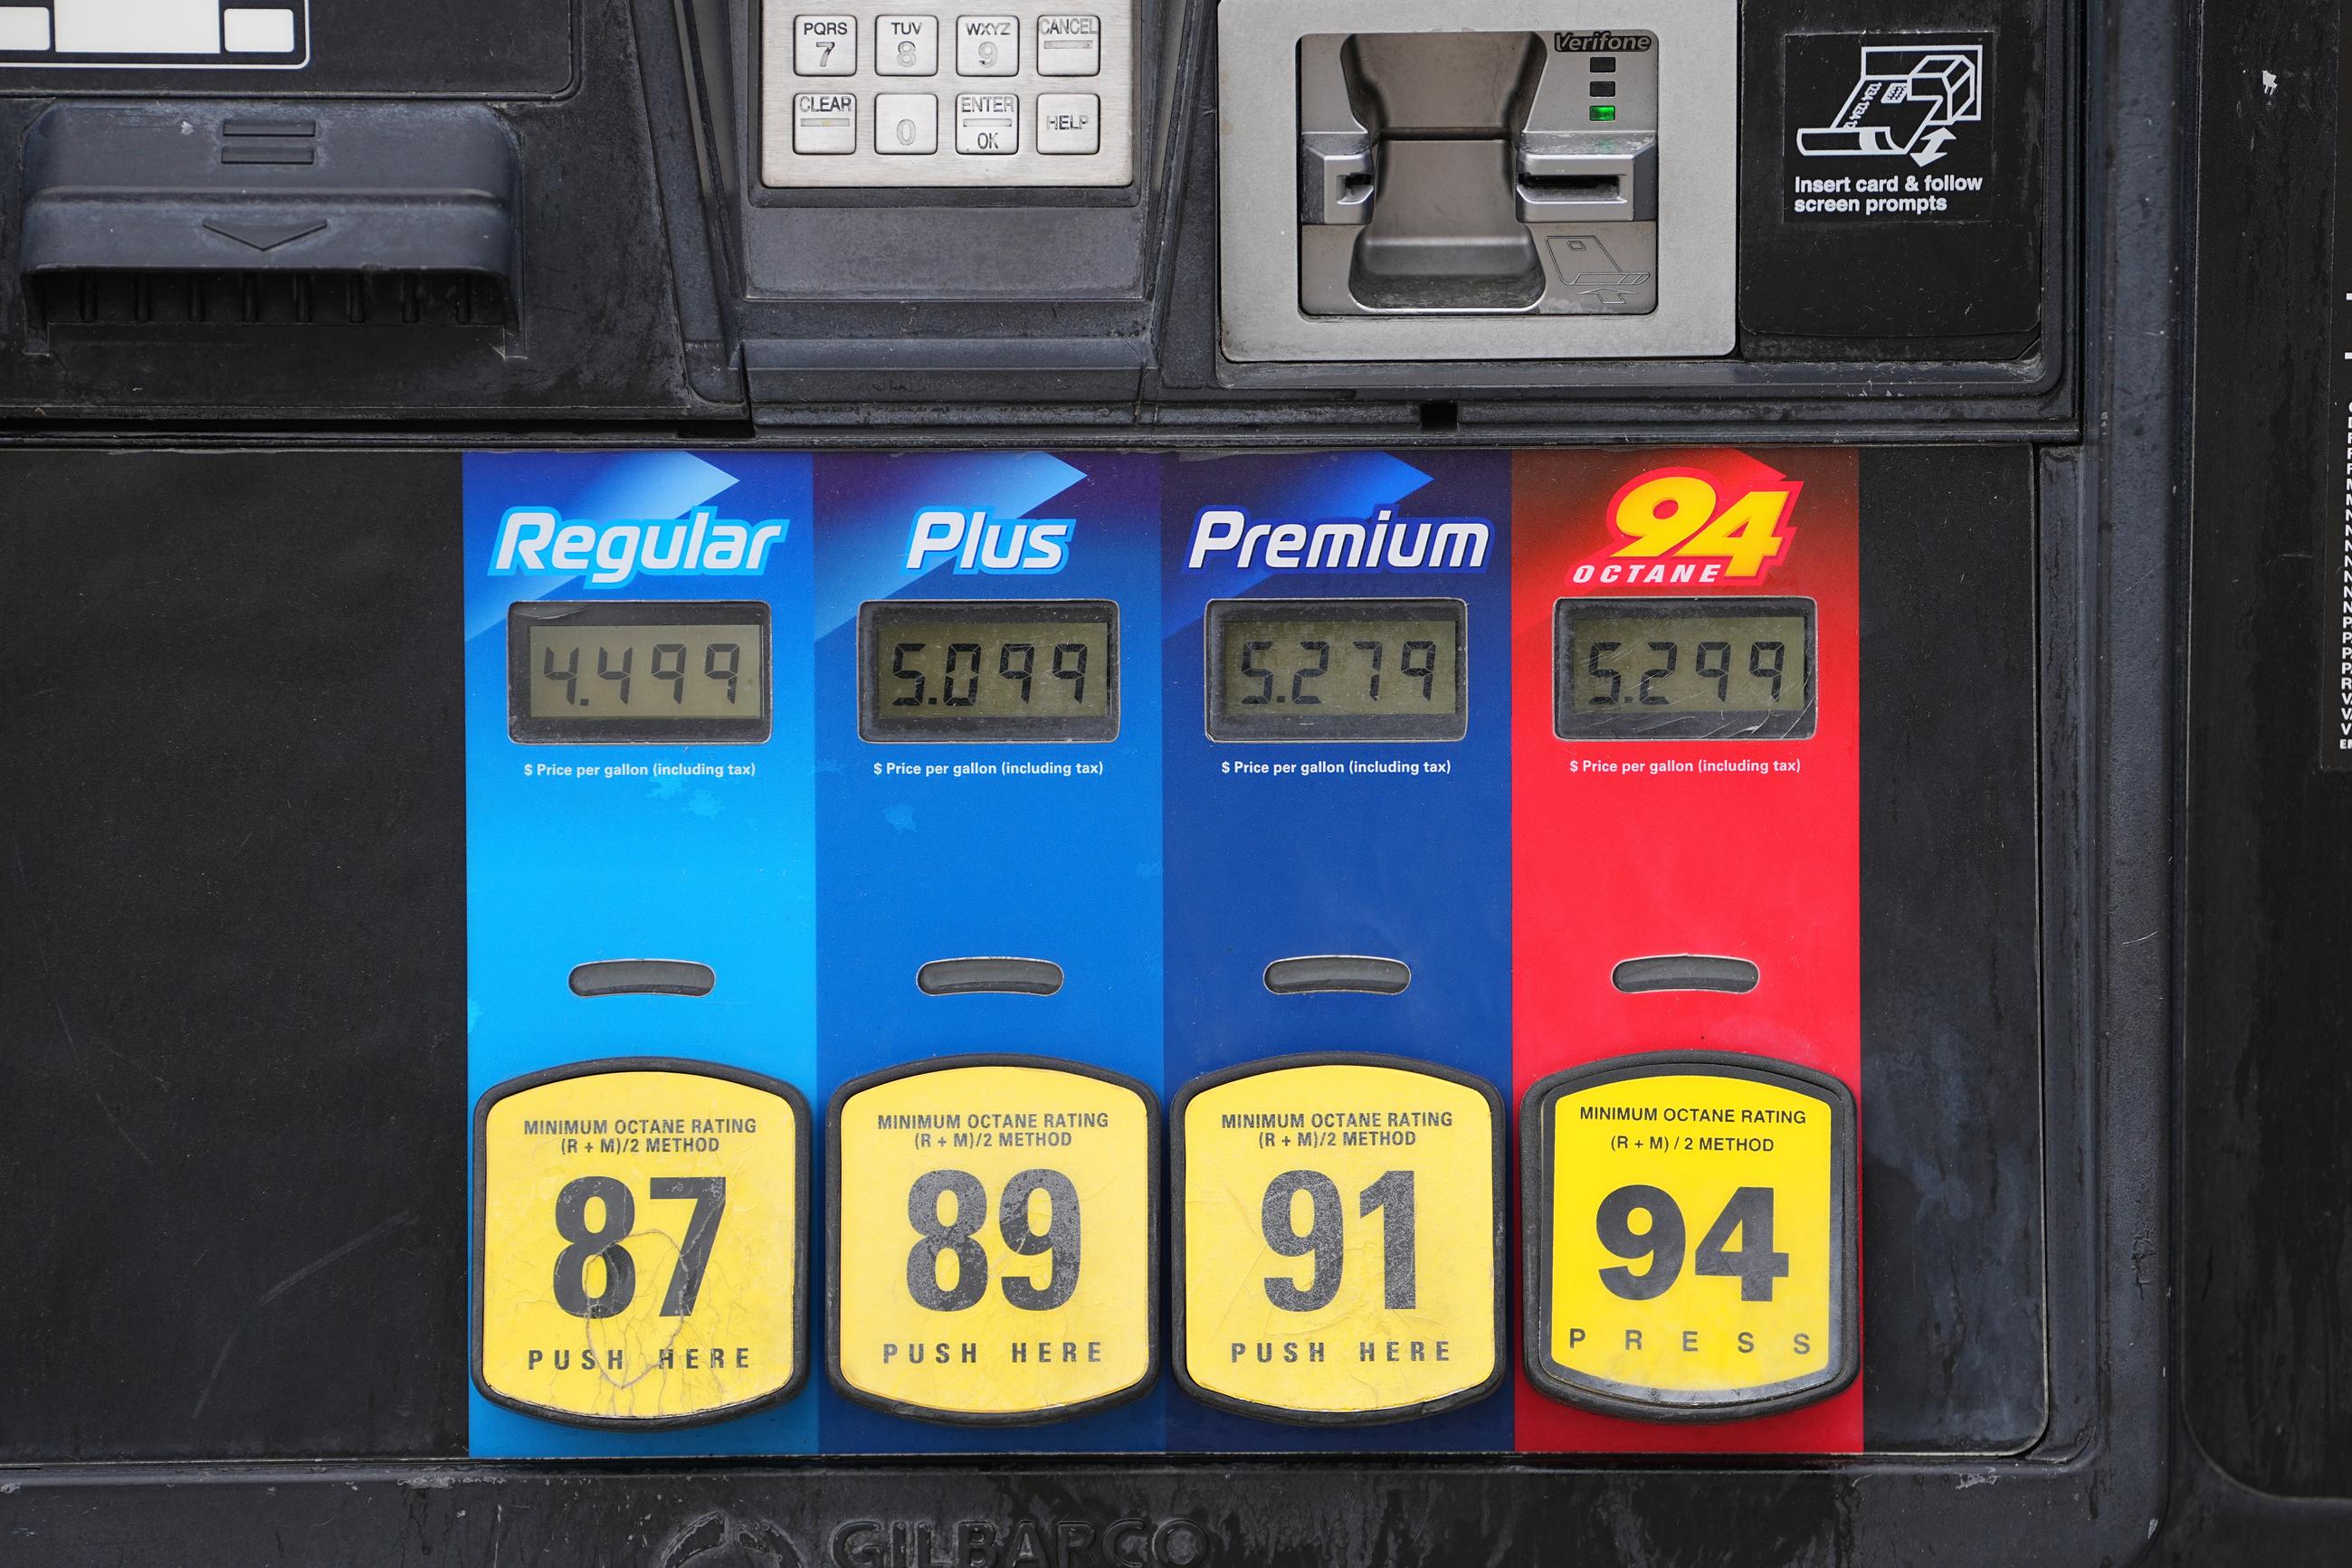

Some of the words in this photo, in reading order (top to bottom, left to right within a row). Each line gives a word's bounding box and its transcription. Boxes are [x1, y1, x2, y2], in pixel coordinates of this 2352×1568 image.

[803, 22, 848, 35] PQRS
[890, 22, 923, 35] TUV
[965, 22, 1011, 35] WXYZ
[1040, 18, 1098, 35] CANCEL
[1555, 31, 1652, 52] Verifone
[815, 42, 835, 68] 7
[897, 42, 916, 68] 8
[978, 42, 997, 68] 9
[799, 96, 852, 113] CLEAR
[961, 96, 1014, 113] ENTER
[1046, 115, 1089, 130] HELP
[977, 132, 999, 149] OK
[1795, 176, 1852, 193] Insert
[1855, 175, 1899, 193] card
[1904, 175, 1919, 192] &
[1924, 174, 1984, 192] follow
[1794, 198, 1861, 213] screen
[1865, 197, 1947, 214] prompts
[1609, 475, 1786, 577] 94
[494, 510, 784, 584] Regular
[905, 510, 1071, 570] Plus
[1188, 510, 1490, 570] Premium
[1572, 564, 1722, 584] OCTANE
[544, 643, 739, 708] 4.499
[892, 642, 1088, 708] 5.099
[1241, 641, 1437, 706] 5.279
[1588, 641, 1785, 706] 5.299
[524, 763, 533, 777] $
[537, 763, 573, 776] Price
[576, 766, 601, 779] per
[604, 763, 649, 779] gallon
[652, 763, 725, 778] (including
[727, 762, 756, 777] tax)
[873, 762, 882, 776] $
[886, 762, 922, 775] Price
[925, 765, 949, 777] per
[952, 761, 997, 777] gallon
[1001, 761, 1072, 777] (including
[1075, 761, 1104, 775] tax)
[1221, 760, 1231, 774] $
[1234, 761, 1270, 774] Price
[1272, 764, 1297, 776] per
[1300, 760, 1345, 776] gallon
[1348, 759, 1420, 776] (including
[1423, 759, 1452, 774] tax)
[1569, 759, 1579, 774] $
[1582, 759, 1618, 773] Price
[1622, 762, 1646, 775] per
[1649, 759, 1694, 775] gallon
[1698, 759, 1769, 774] (including
[1772, 758, 1801, 774] tax)
[877, 1114, 961, 1130] MINIMUM
[967, 1113, 1037, 1129] OCTANE
[1043, 1112, 1109, 1128] RATING
[1222, 1113, 1305, 1129] MINIMUM
[1310, 1112, 1382, 1128] OCTANE
[1387, 1111, 1452, 1127] RATING
[1580, 1106, 1658, 1121] MINIMUM
[1663, 1107, 1735, 1123] OCTANE
[1741, 1109, 1806, 1125] RATING
[524, 1119, 607, 1136] MINIMUM
[614, 1118, 685, 1135] OCTANE
[691, 1117, 757, 1134] RATING
[561, 1137, 578, 1155] (R
[584, 1142, 594, 1154] +
[600, 1137, 639, 1155] M)/2
[645, 1136, 719, 1153] METHOD
[914, 1132, 931, 1150] (R
[937, 1136, 947, 1148] +
[953, 1132, 993, 1150] M)/2
[998, 1131, 1072, 1147] METHOD
[1259, 1131, 1276, 1149] (R
[1281, 1136, 1291, 1147] +
[1297, 1131, 1337, 1149] M)/2
[1342, 1130, 1416, 1146] METHOD
[1611, 1135, 1629, 1152] (R
[1633, 1139, 1644, 1149] +
[1650, 1136, 1670, 1153] M)
[1673, 1136, 1680, 1150] /
[1684, 1136, 1693, 1151] 2
[1699, 1136, 1775, 1152] METHOD
[552, 1175, 727, 1320] 87
[906, 1168, 1081, 1313] 89
[1261, 1169, 1416, 1313] 91
[1595, 1183, 1789, 1303] 94
[528, 1348, 624, 1371] PUSH
[659, 1347, 750, 1370] HERE
[882, 1342, 976, 1364] PUSH
[1012, 1341, 1101, 1364] HERE
[1231, 1341, 1325, 1364] PUSH
[1359, 1340, 1450, 1363] HERE
[832, 1518, 1210, 1568] GILBARCO
